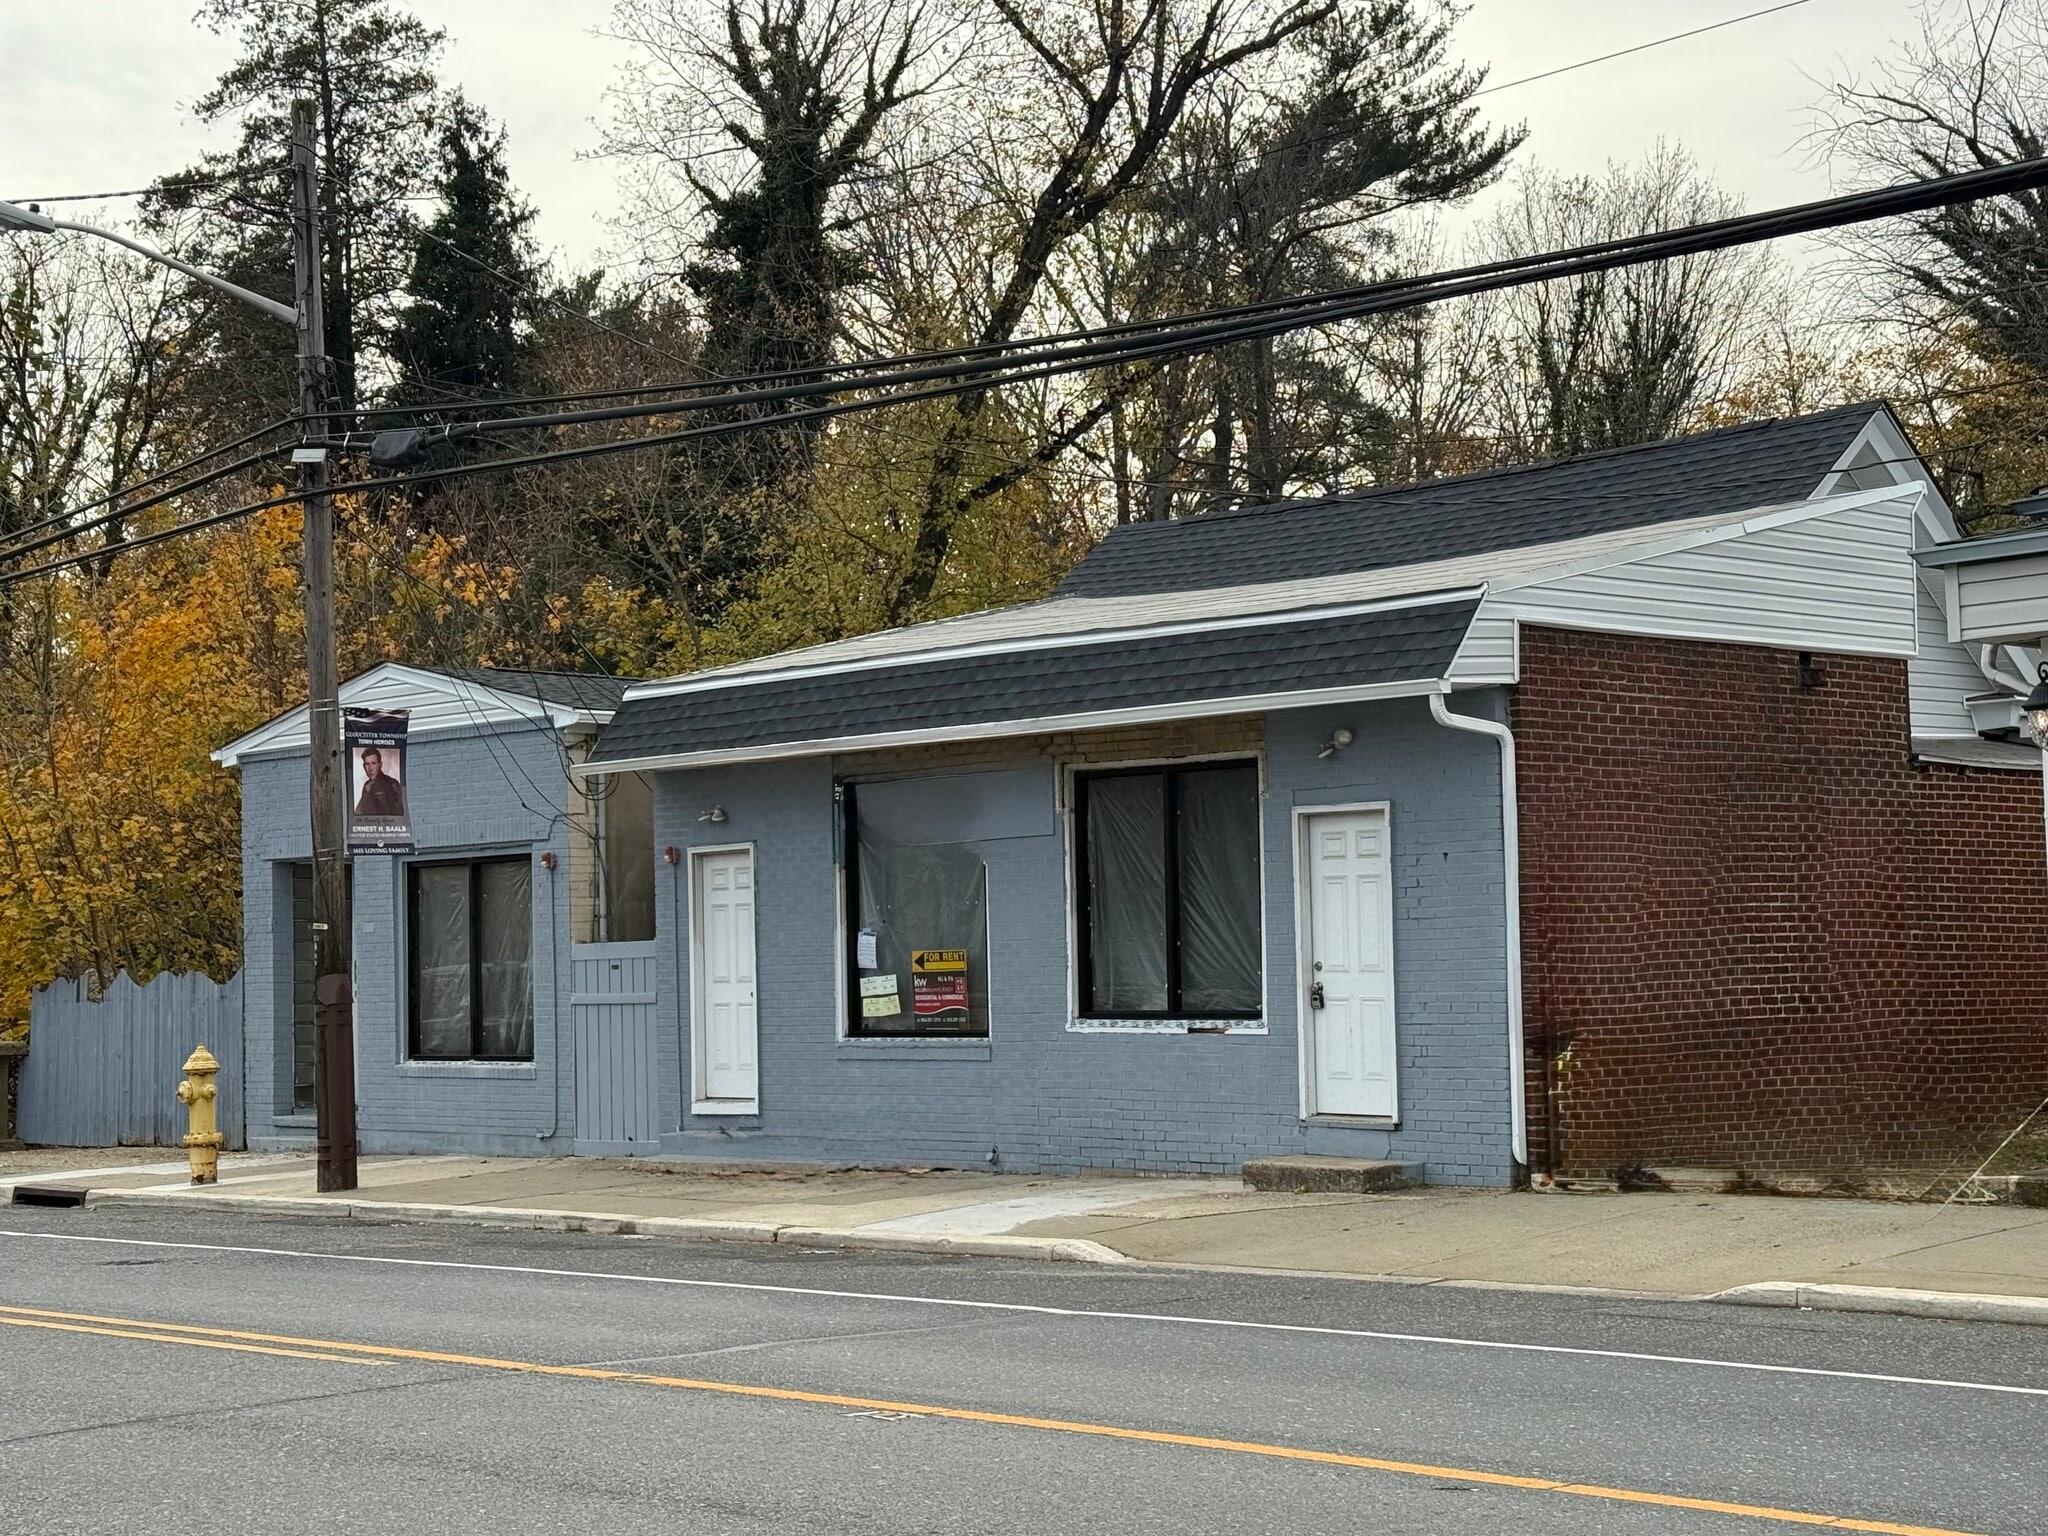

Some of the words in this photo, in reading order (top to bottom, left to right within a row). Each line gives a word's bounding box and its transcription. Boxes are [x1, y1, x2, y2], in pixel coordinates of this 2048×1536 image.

[352, 825, 377, 833] ERNEST
[924, 952, 940, 961] FOR
[942, 951, 964, 961] RENT
[913, 974, 928, 987] kw
